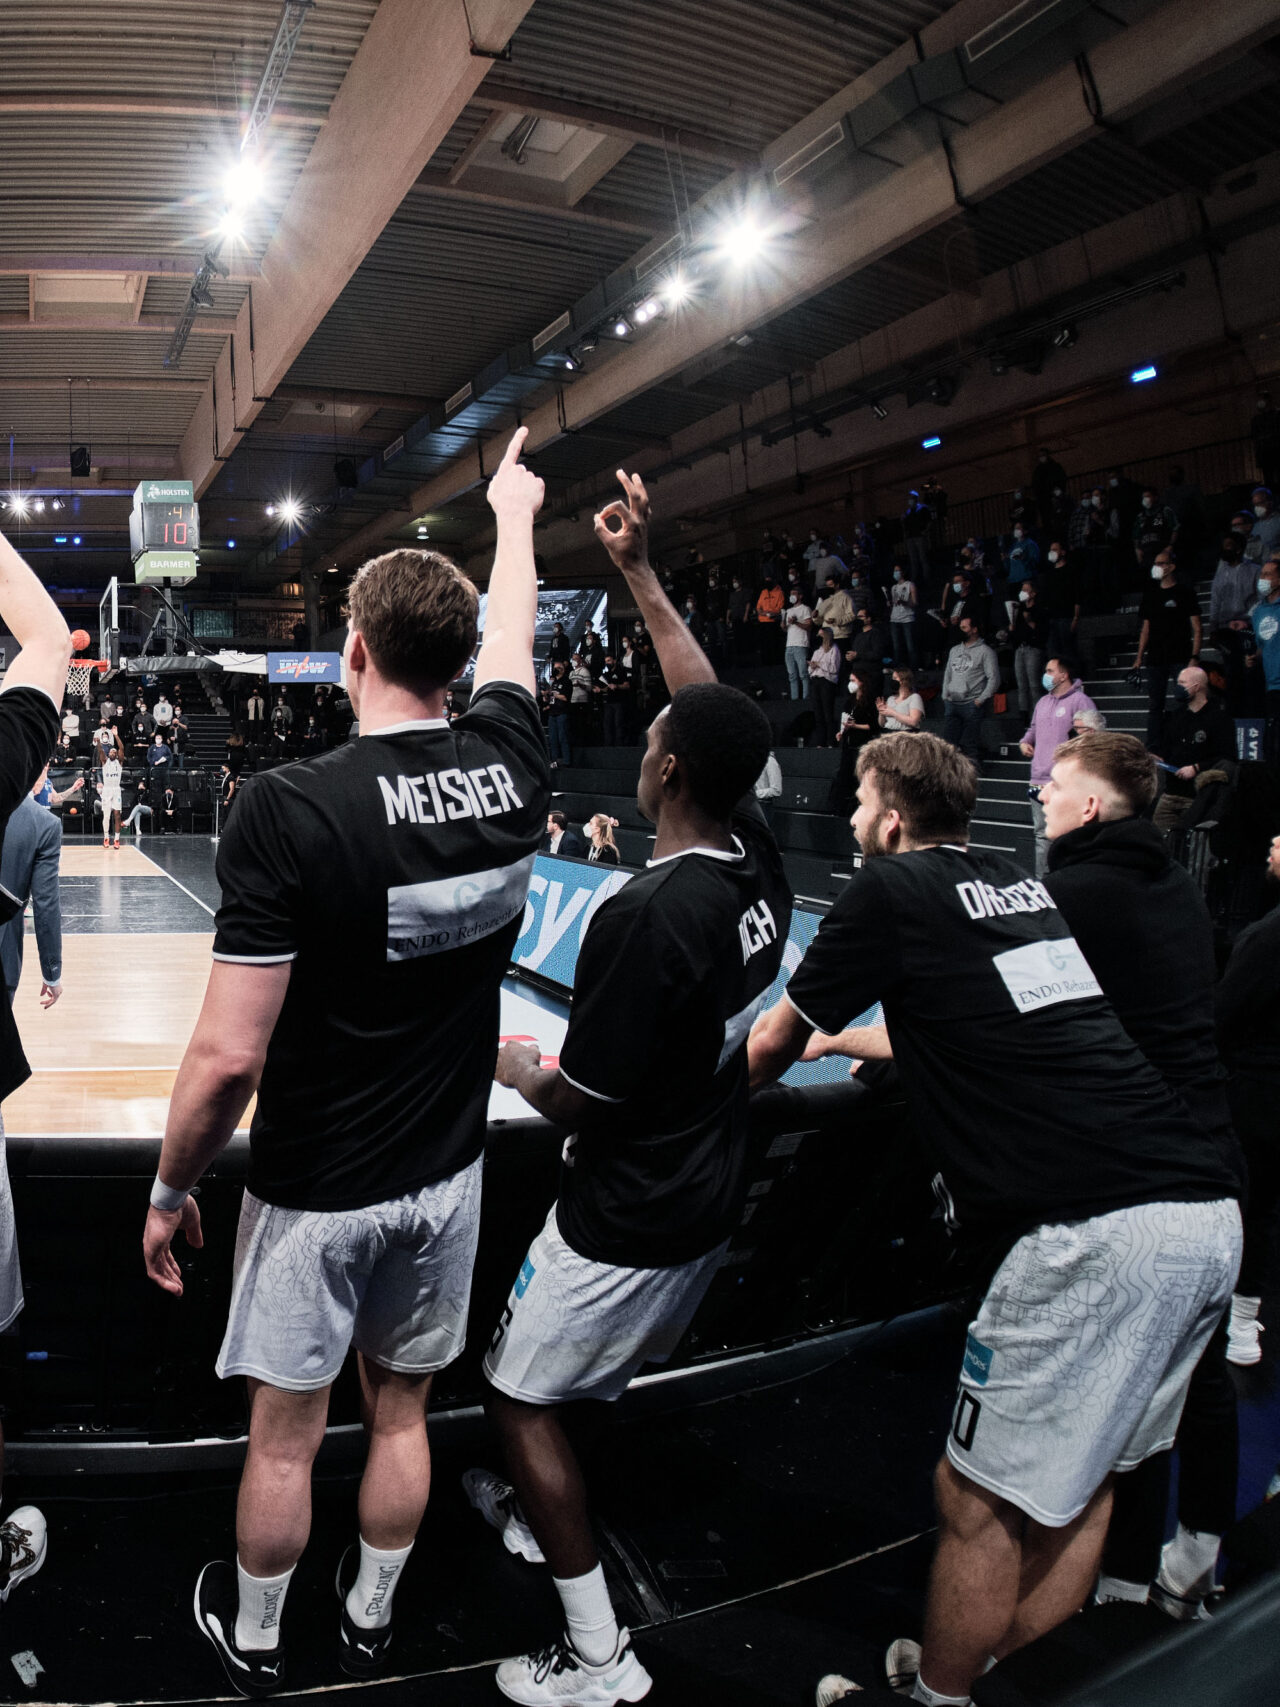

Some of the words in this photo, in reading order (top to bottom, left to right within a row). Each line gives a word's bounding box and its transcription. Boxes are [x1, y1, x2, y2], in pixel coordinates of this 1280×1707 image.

[161, 488, 190, 497] HOLSTEN
[164, 522, 187, 545] 10
[150, 560, 191, 569] BARMER
[1019, 982, 1063, 1005] ENDO
[365, 1564, 399, 1617] SPALDING
[261, 1586, 283, 1630] SPALDING
